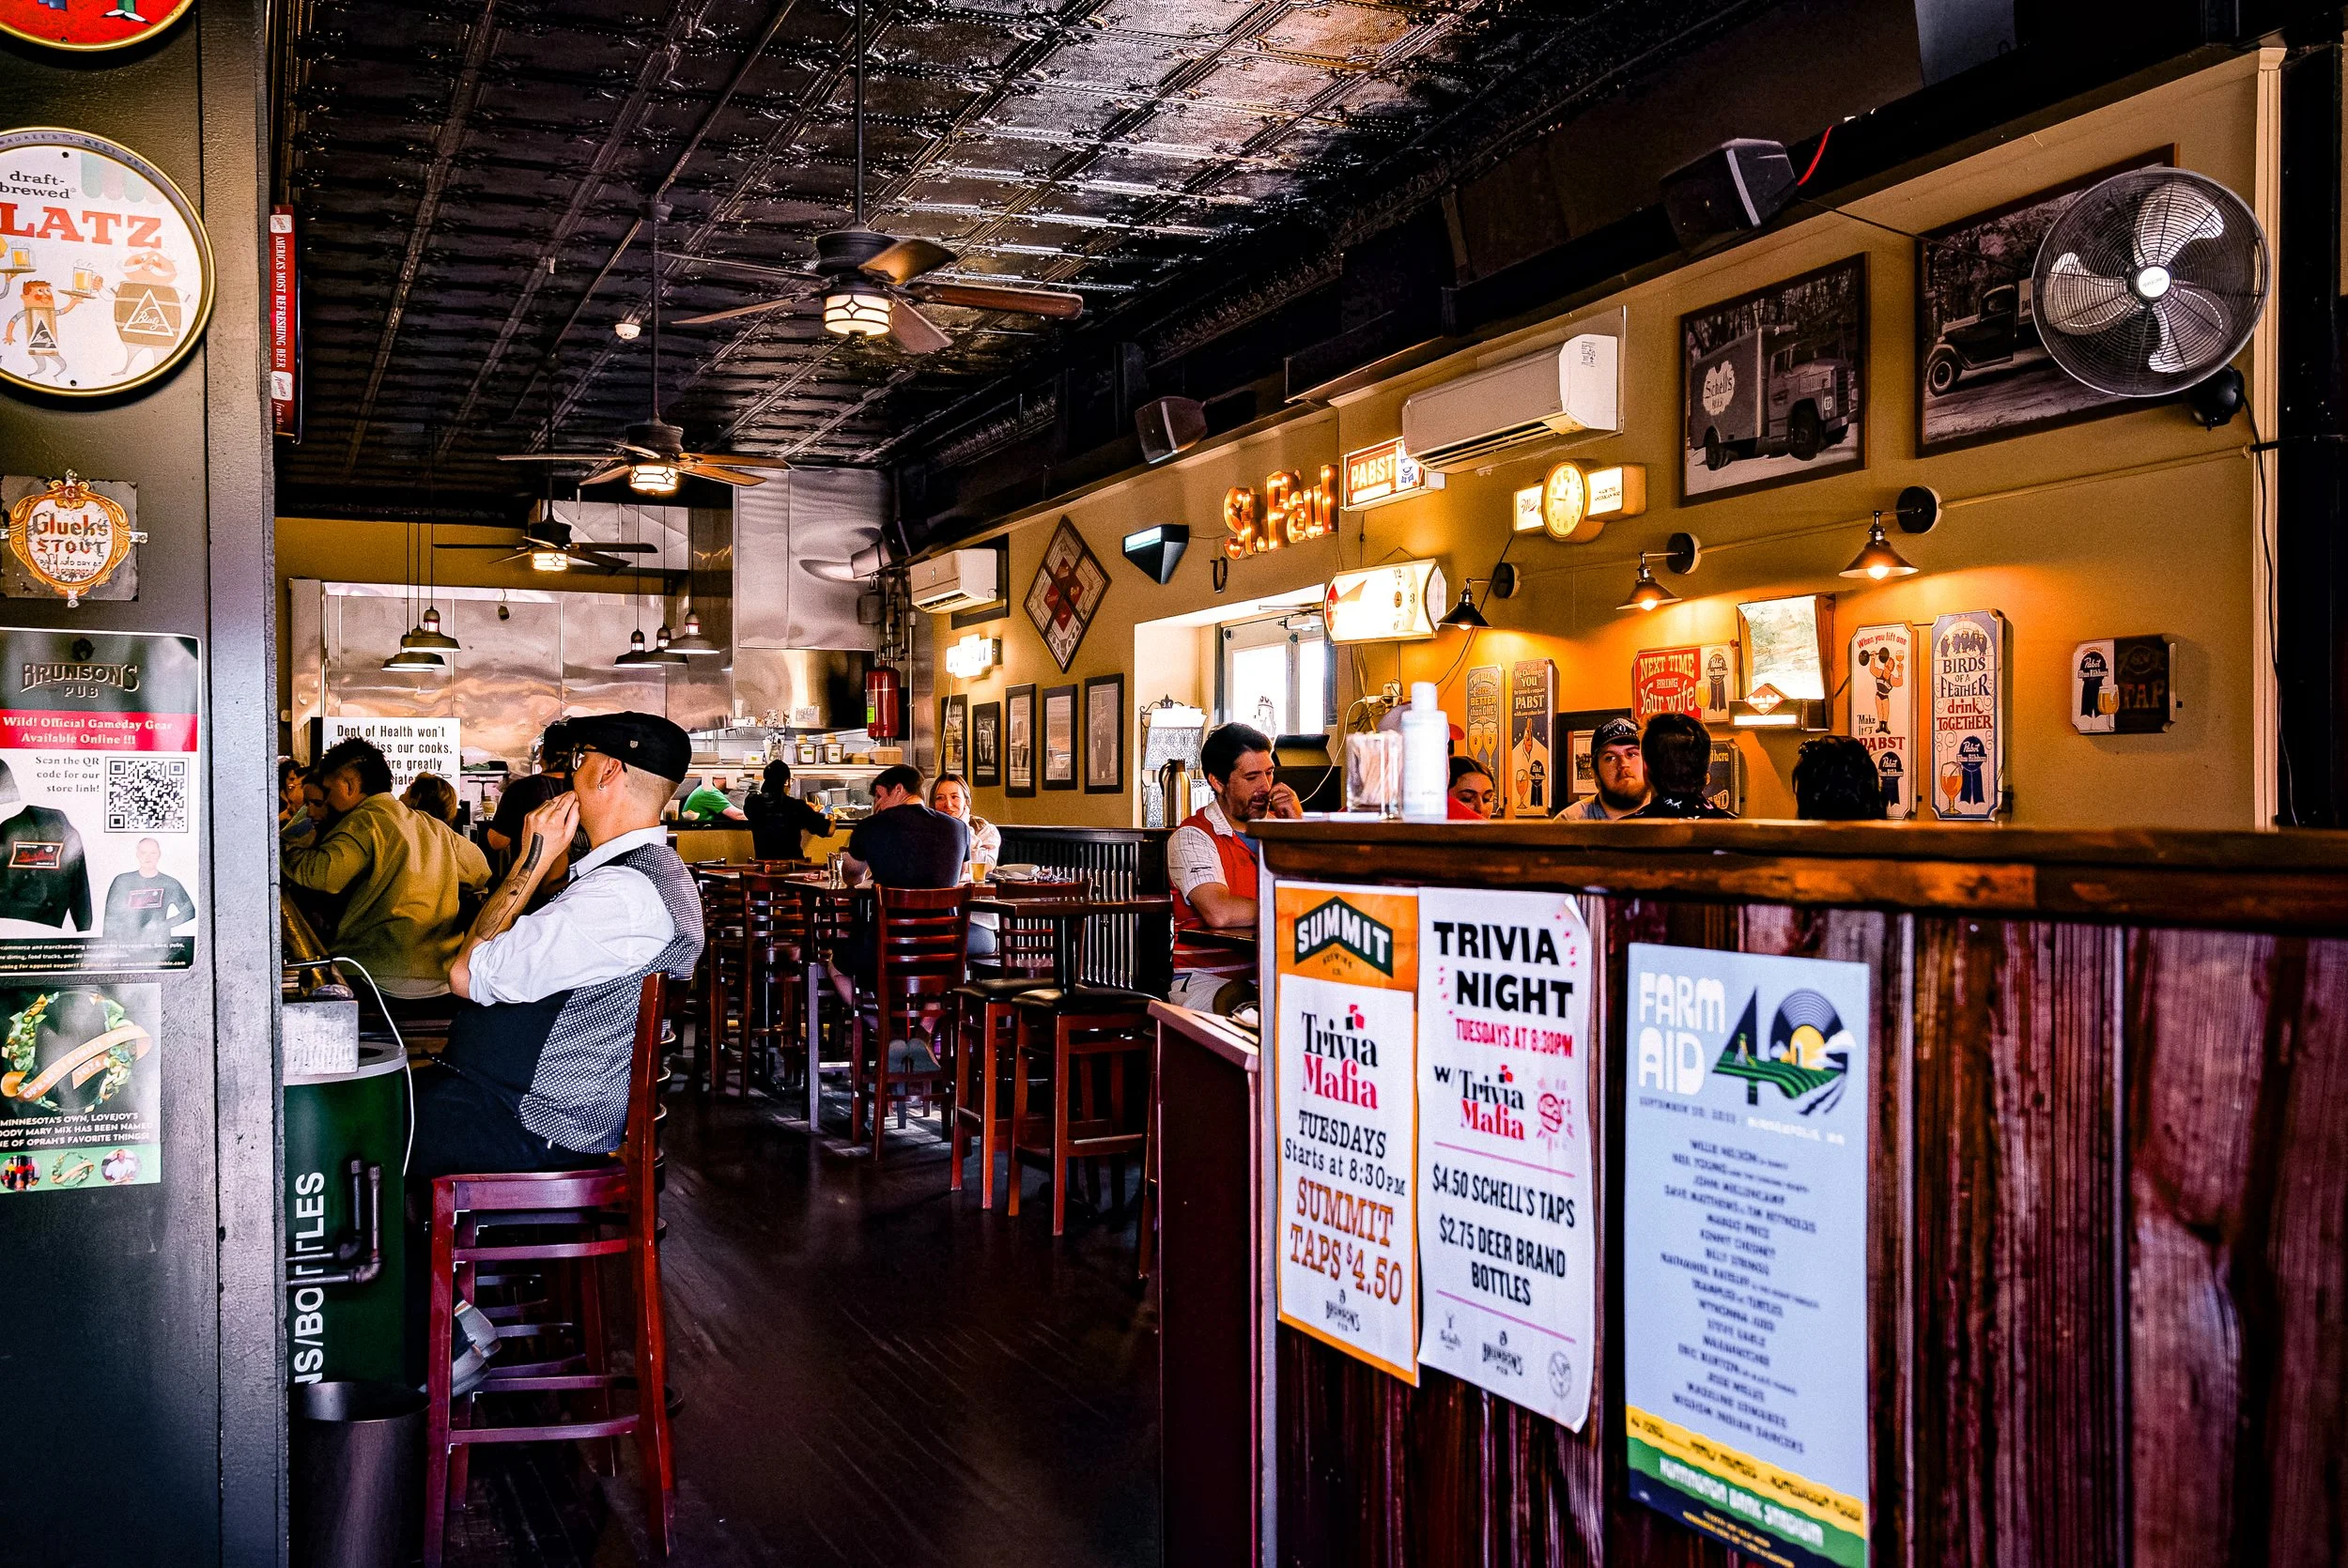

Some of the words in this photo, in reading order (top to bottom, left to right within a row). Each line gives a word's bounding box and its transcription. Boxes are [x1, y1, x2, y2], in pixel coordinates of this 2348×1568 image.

[9, 171, 65, 186] draft-
[275, 269, 286, 293] MOST
[275, 295, 286, 346] REFRESHING
[275, 348, 286, 368] BEER
[1351, 453, 1396, 490] PABST
[1266, 465, 1337, 549] Paul
[31, 510, 108, 536] Gluek's
[37, 538, 107, 555] STOUT
[1857, 638, 1874, 650] When
[1875, 634, 1885, 646] you
[1886, 632, 1896, 642] lift
[1896, 635, 1908, 646] one
[1640, 655, 1666, 683] NEXT
[1668, 653, 1694, 679] TIME
[1942, 657, 1986, 674] BIRDS
[1522, 676, 1537, 687] YOU
[1656, 677, 1678, 689] BRING
[1954, 674, 1964, 683] OF
[1965, 674, 1970, 683] A
[64, 685, 100, 699] PUB
[1470, 696, 1497, 706] BETTER
[1515, 694, 1545, 709] PABST
[1640, 682, 1665, 715] Your
[1666, 679, 1695, 715] wife
[2120, 680, 2166, 710] TAP
[1470, 707, 1482, 716] than
[1947, 697, 1985, 715] drink
[3, 716, 38, 728] Wild!
[40, 716, 85, 729] Official
[87, 718, 142, 731] Gameday
[144, 719, 174, 730] Gear
[1857, 715, 1877, 725] Make
[21, 732, 77, 744] Available
[80, 733, 121, 745] Online
[337, 724, 361, 737] Dept
[365, 725, 376, 737] of
[379, 725, 413, 738] Health
[417, 726, 445, 738] won't
[397, 743, 413, 754] our
[418, 742, 453, 755] cooks,
[1859, 736, 1906, 751] PABST
[1962, 741, 1980, 753] Pabst
[36, 756, 60, 765] Scan
[63, 756, 80, 765] the
[82, 758, 100, 766] QR
[407, 758, 442, 772] greatly
[37, 770, 62, 779] code
[64, 770, 80, 779] for
[1297, 902, 1390, 965] SUMMIT
[1432, 920, 1560, 966] TRIVIA
[1456, 969, 1574, 1019] NIGHT
[1639, 971, 1726, 1034] FARM
[1301, 1010, 1378, 1068] Trivia
[1456, 1018, 1510, 1048] TUESDAYS
[1513, 1027, 1527, 1051] AT
[1638, 1026, 1706, 1096] AID
[1302, 1053, 1379, 1110] Mafia
[1459, 1067, 1524, 1110] Trivia
[0, 1116, 63, 1127] MINNESOTA'S
[63, 1115, 89, 1124] OWN,
[91, 1112, 139, 1122] LOVEJOY'S
[25, 1128, 53, 1137] MARY
[73, 1125, 92, 1133] HAS
[94, 1124, 118, 1132] BEEN
[120, 1122, 152, 1131] NAMED
[1460, 1098, 1526, 1141] Mafia
[11, 1139, 25, 1147] OF
[26, 1137, 66, 1146] OPRAH'S
[67, 1134, 112, 1144] FAVORITE
[1299, 1109, 1386, 1160] TUESDAYS
[1285, 1137, 1324, 1172] Starts
[1328, 1154, 1343, 1178] at
[1350, 1158, 1406, 1196] 8:30PM
[1432, 1161, 1468, 1199] $4.50
[1471, 1175, 1535, 1217] SCHELL'S
[1539, 1191, 1575, 1228] TAPS
[1296, 1176, 1394, 1248] SUMMIT
[1439, 1214, 1475, 1251] $2.75
[1477, 1227, 1512, 1263] DEER
[1515, 1237, 1567, 1278] BRAND
[1290, 1222, 1341, 1281] TAPS
[1346, 1242, 1403, 1306] $4.50
[1471, 1261, 1532, 1306] BOTTLES
